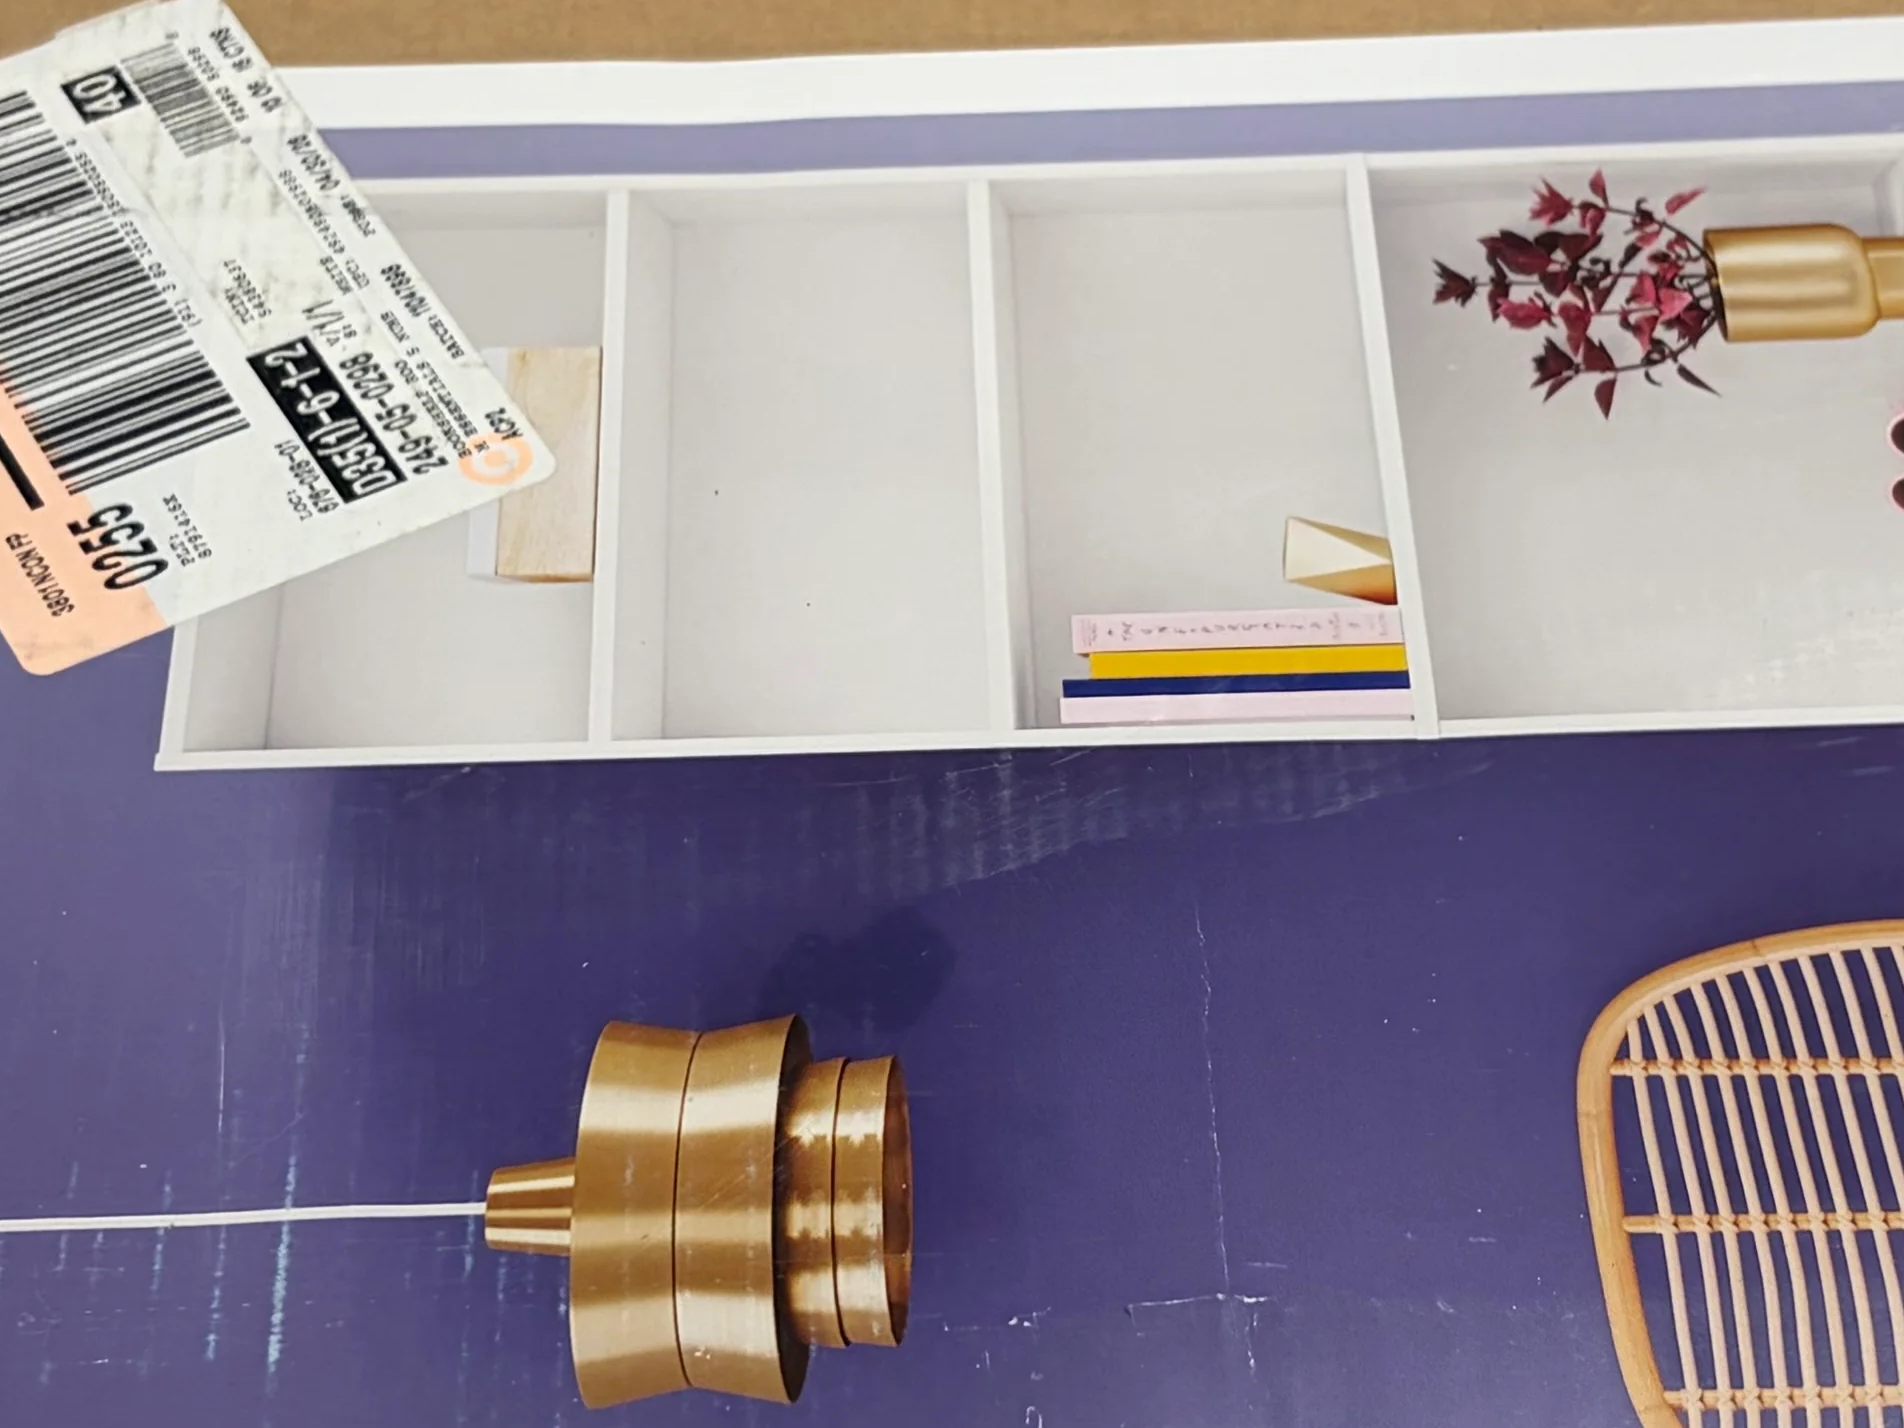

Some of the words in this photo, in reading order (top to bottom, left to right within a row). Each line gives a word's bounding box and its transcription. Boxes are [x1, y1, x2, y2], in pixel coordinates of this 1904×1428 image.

[66, 70, 134, 119] 40
[252, 338, 400, 501] D35(1)-6-1-2
[334, 348, 451, 478] 249-05-0298
[64, 498, 173, 595] 0255
[282, 487, 315, 521] LOC:
